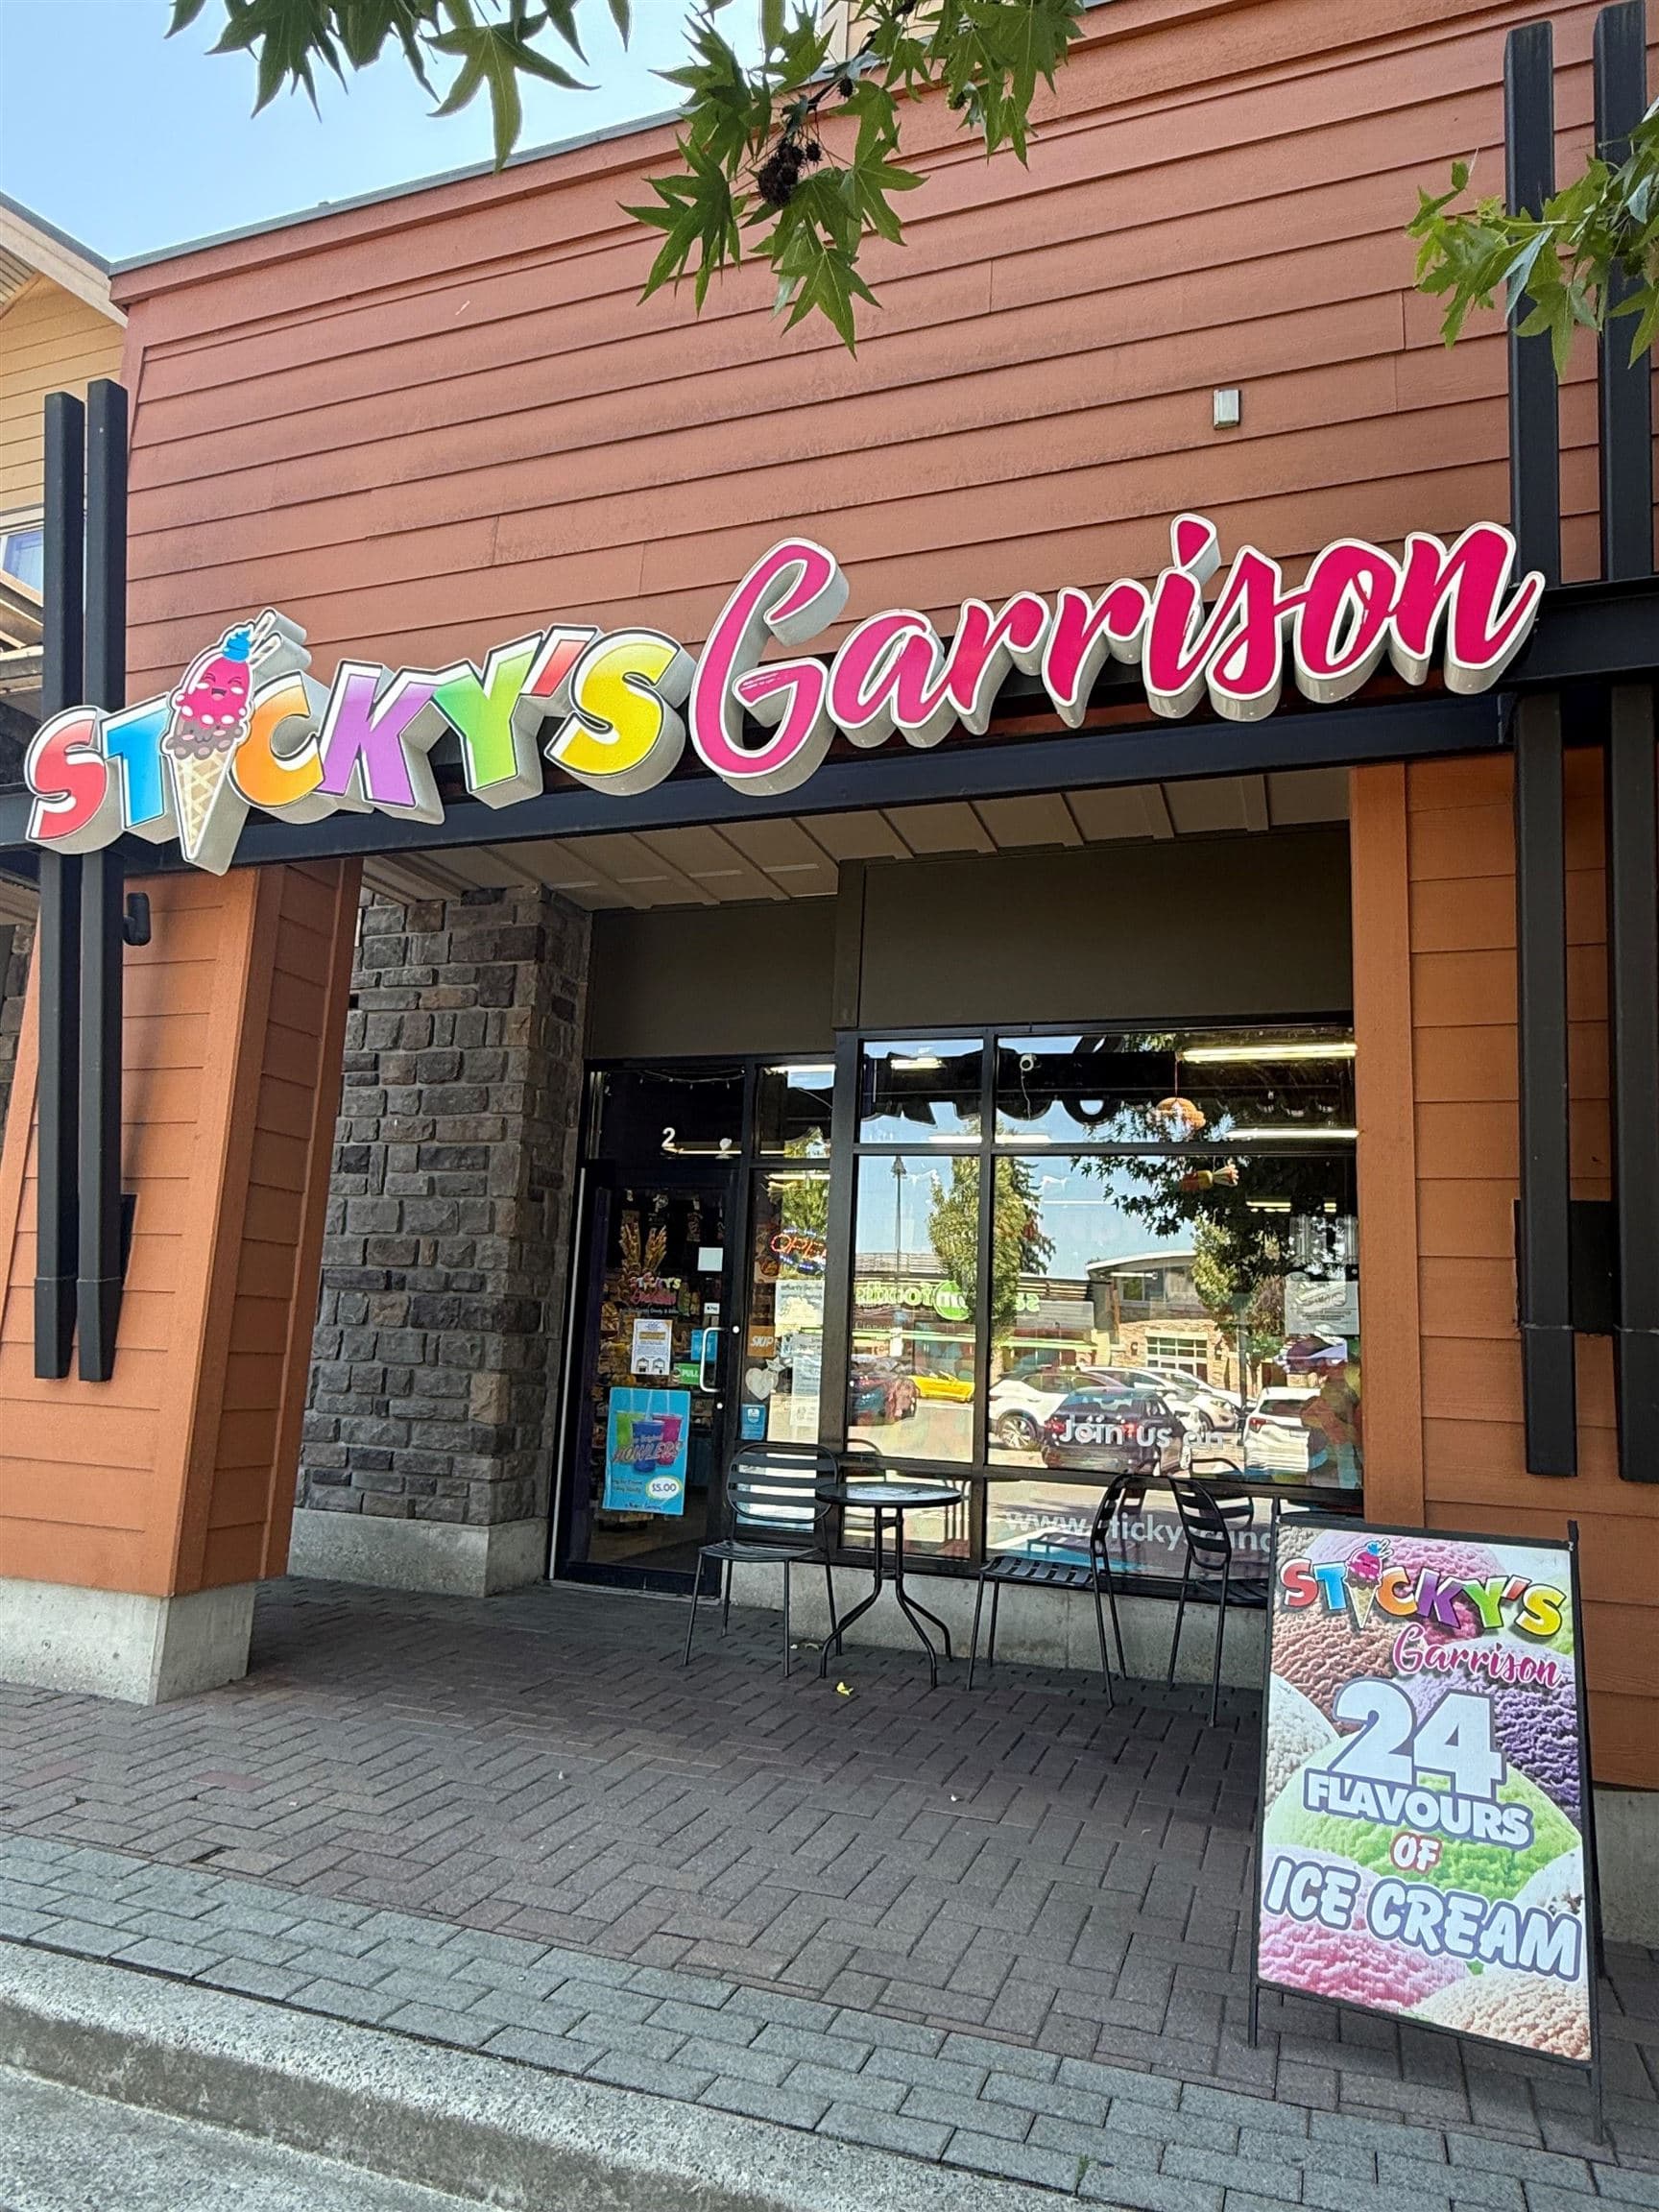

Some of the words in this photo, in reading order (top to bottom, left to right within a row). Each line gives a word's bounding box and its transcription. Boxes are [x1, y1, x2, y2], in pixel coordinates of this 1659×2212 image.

[689, 512, 1547, 789] Garrison
[661, 1127, 675, 1147] 2
[771, 1234, 826, 1260] OPE
[682, 1369, 699, 1378] PULL
[1059, 1413, 1123, 1446] Join
[1136, 1427, 1173, 1449] us
[1392, 1623, 1564, 1689] Garrison
[1334, 1678, 1503, 1801] 24
[1305, 1769, 1532, 1847] FLAVOURS
[1391, 1833, 1441, 1872] OF
[1264, 1857, 1359, 1929] ICE
[1368, 1878, 1582, 1980] CREAM
